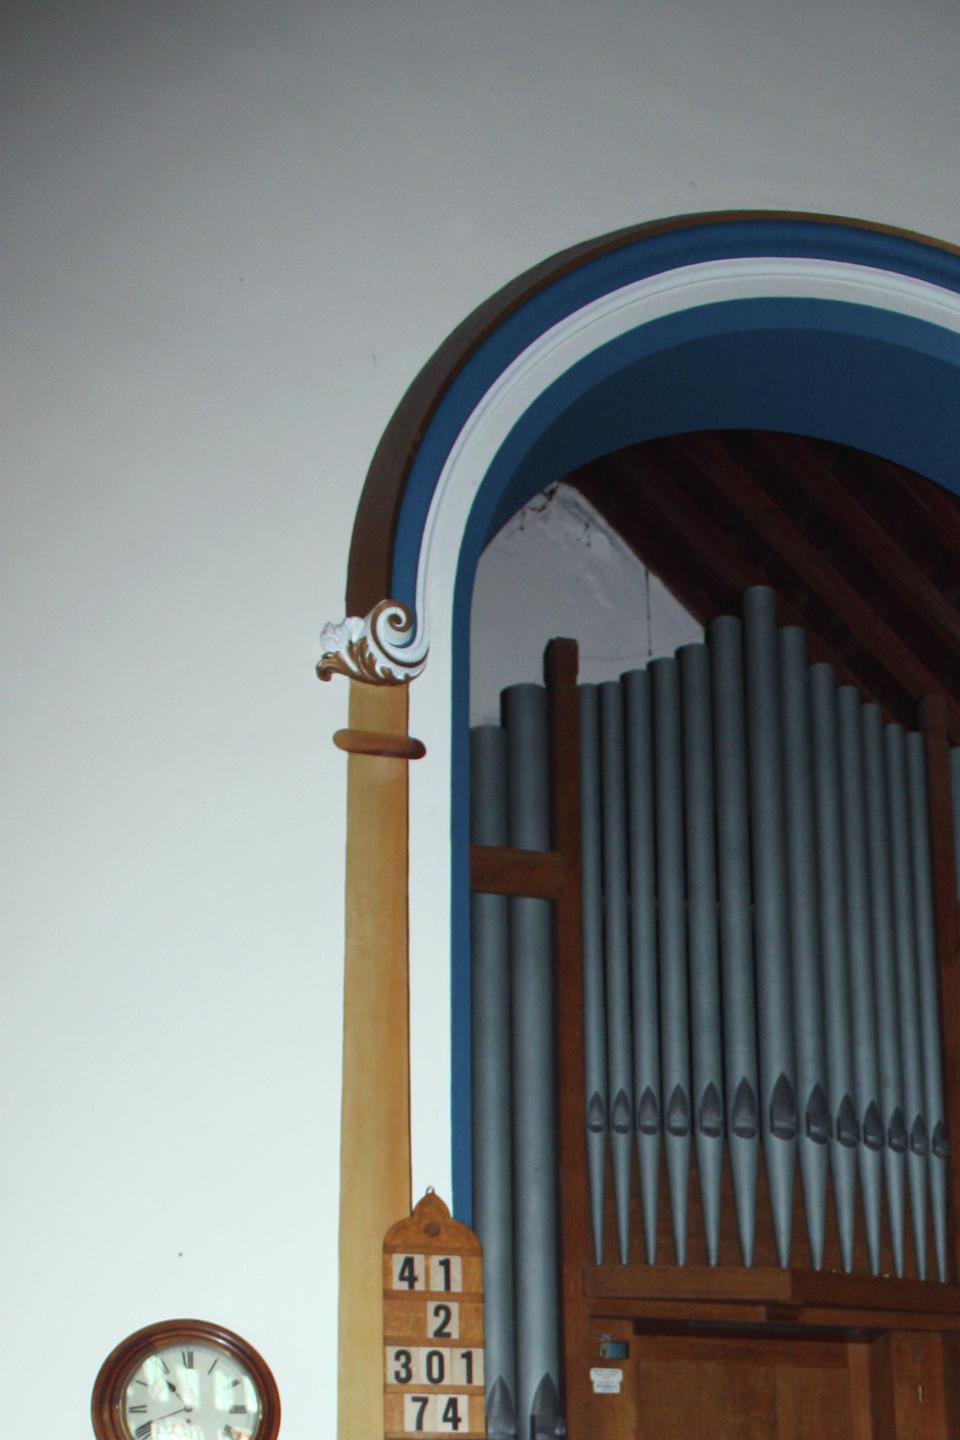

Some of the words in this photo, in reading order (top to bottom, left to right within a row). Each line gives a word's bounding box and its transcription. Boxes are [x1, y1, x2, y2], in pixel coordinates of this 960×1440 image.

[398, 1256, 450, 1292] 41
[433, 1303, 452, 1339] 2
[394, 1349, 473, 1384] 301
[411, 1396, 462, 1431] 74
